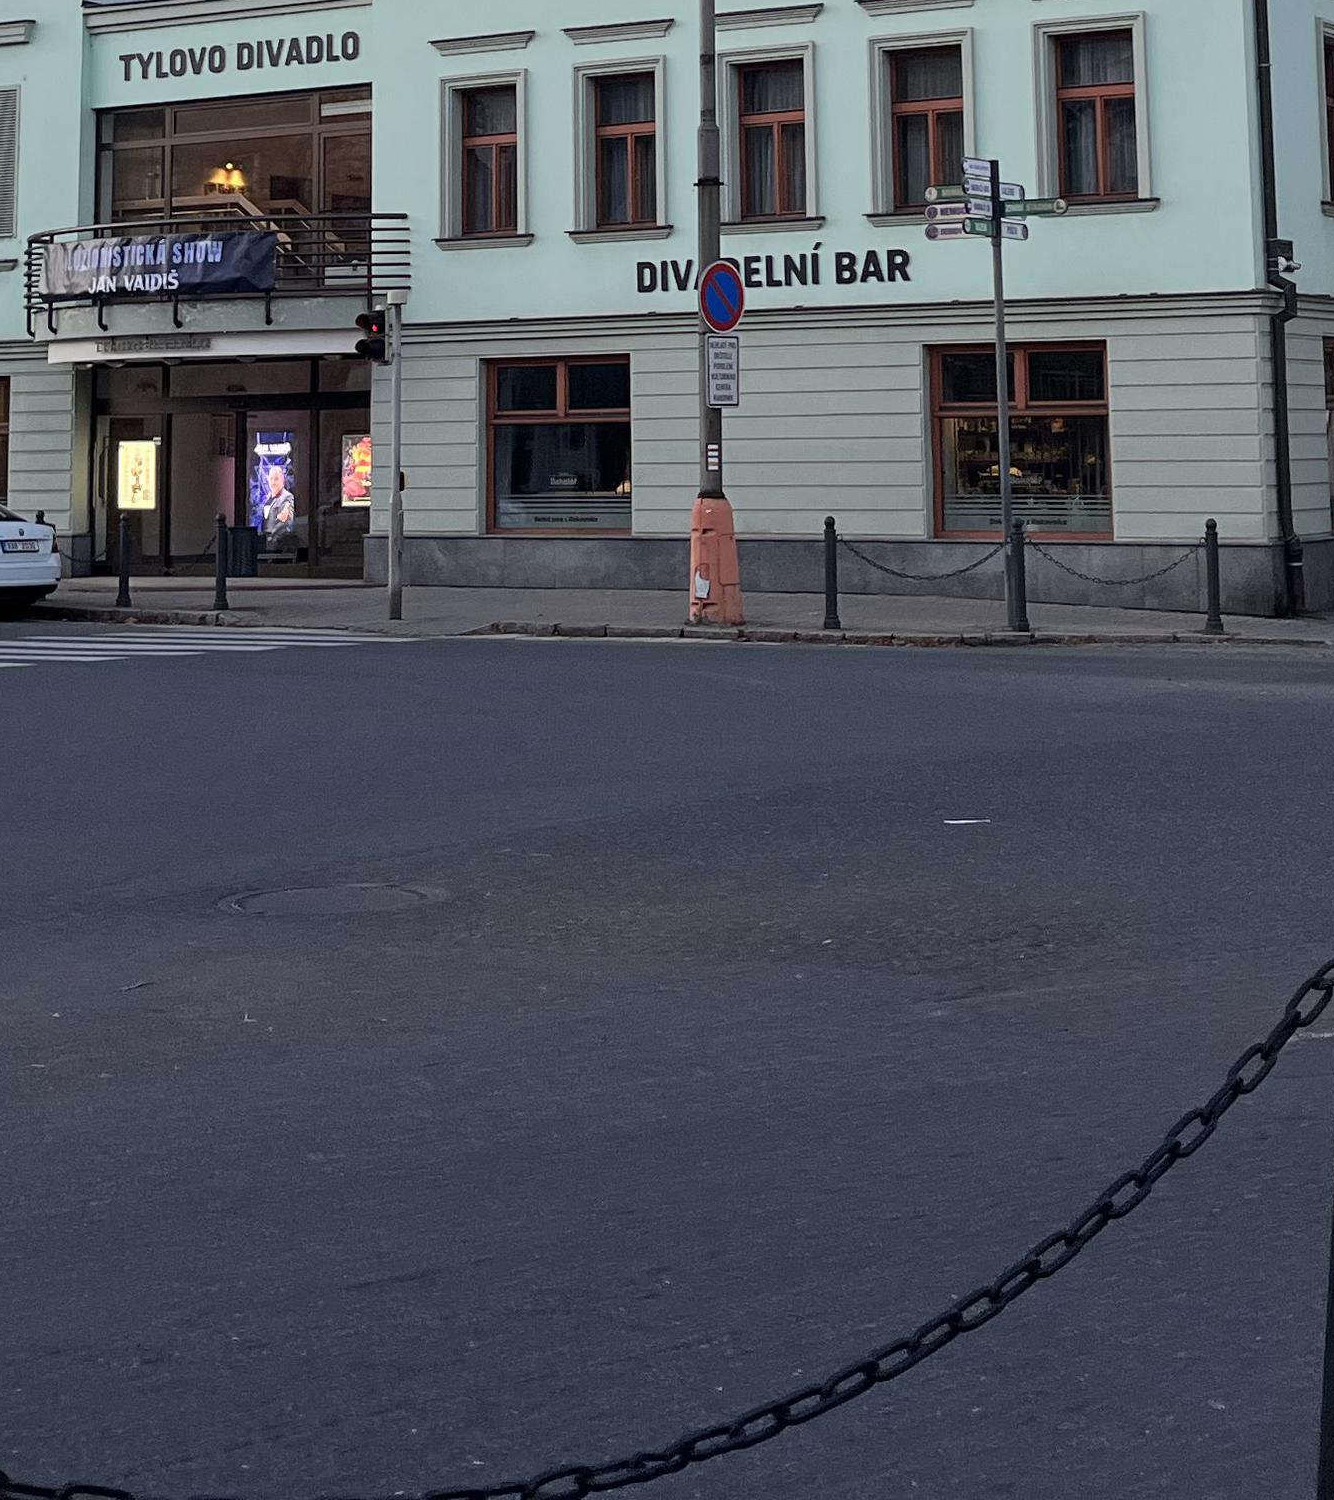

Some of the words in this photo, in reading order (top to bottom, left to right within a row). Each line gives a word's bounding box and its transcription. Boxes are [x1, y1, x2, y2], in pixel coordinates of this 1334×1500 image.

[119, 45, 226, 82] TYLOVO
[236, 31, 360, 71] DIVADLO
[173, 240, 224, 264] SHOW
[636, 242, 822, 293] DIVELNÍ
[835, 249, 911, 285] BAR
[87, 276, 117, 294] JAN
[123, 269, 179, 292] VAIDIŠ
